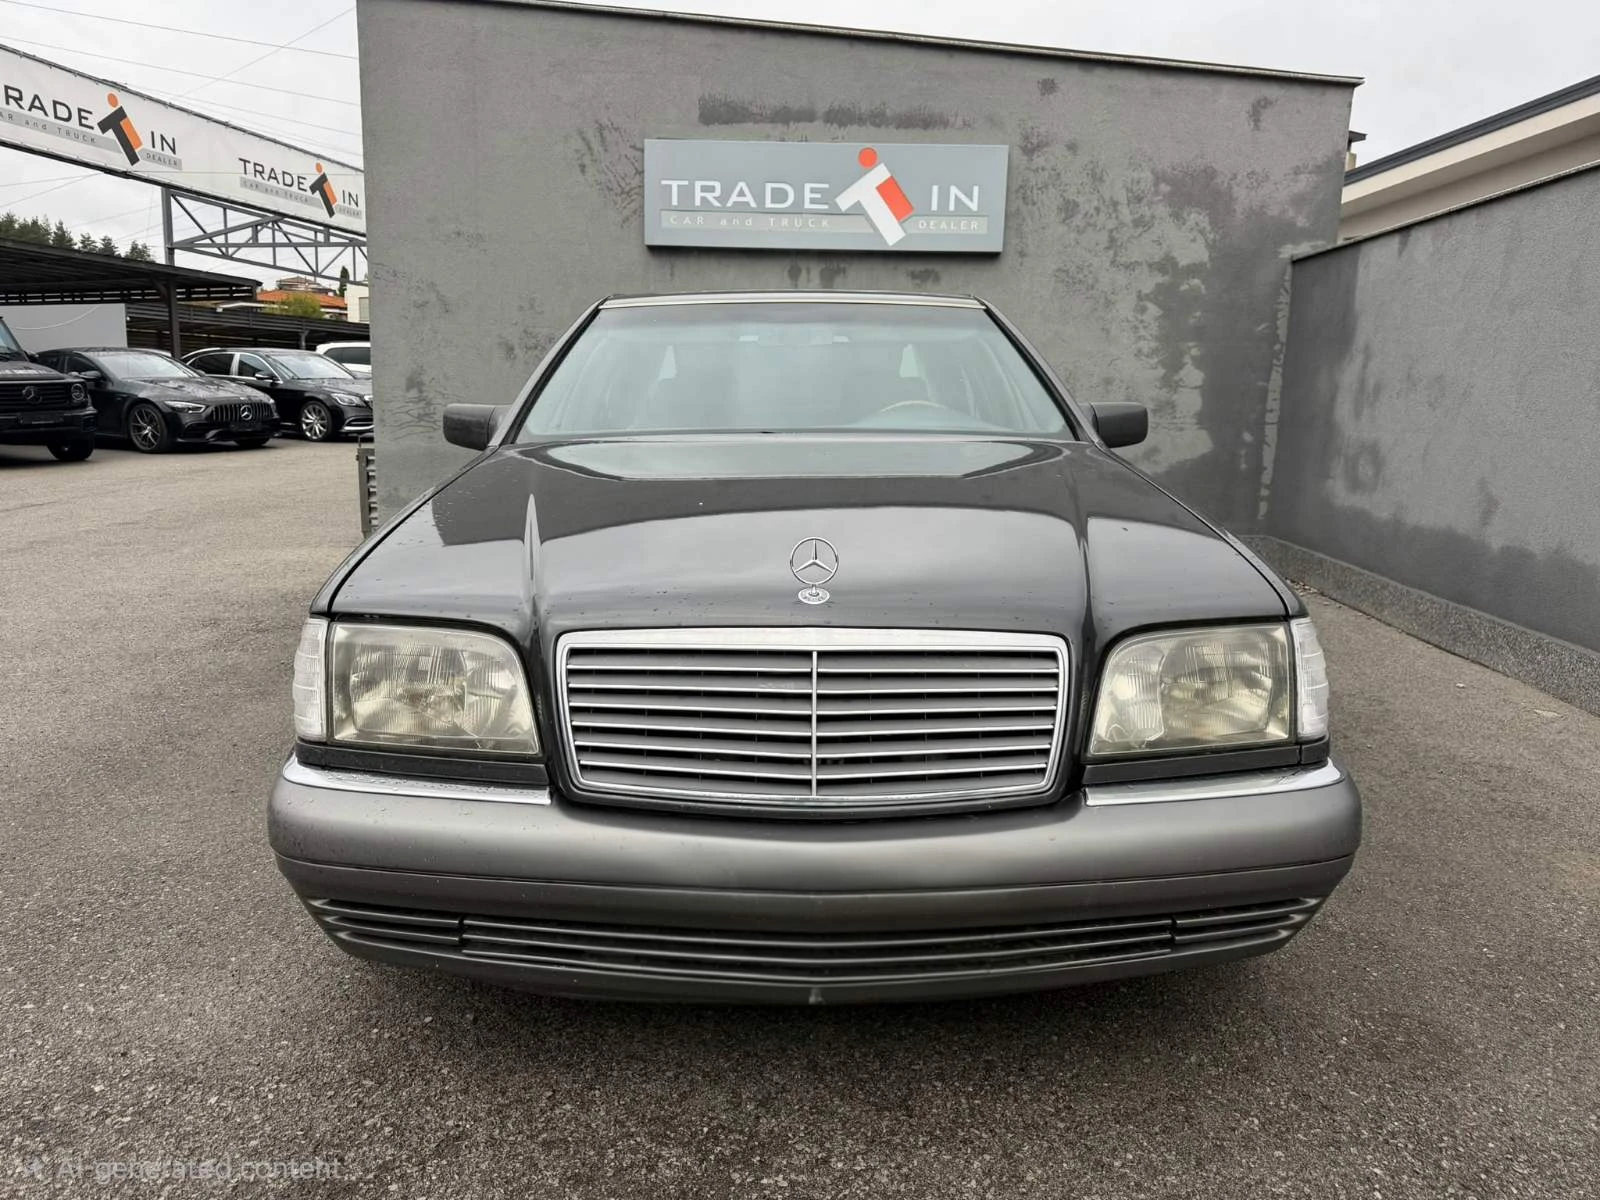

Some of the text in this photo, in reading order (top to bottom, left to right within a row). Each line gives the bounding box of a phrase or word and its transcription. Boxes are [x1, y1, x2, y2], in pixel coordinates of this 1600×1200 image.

[0, 111, 14, 121] AR
[146, 152, 178, 166] DEALER
[4, 84, 95, 131] RADE
[150, 130, 177, 156] IN
[238, 157, 308, 193] TRADE
[342, 188, 359, 208] IN
[660, 179, 830, 210] TRADE
[930, 184, 980, 213] IN
[669, 214, 979, 231] CAR and TRUCK DEALER
